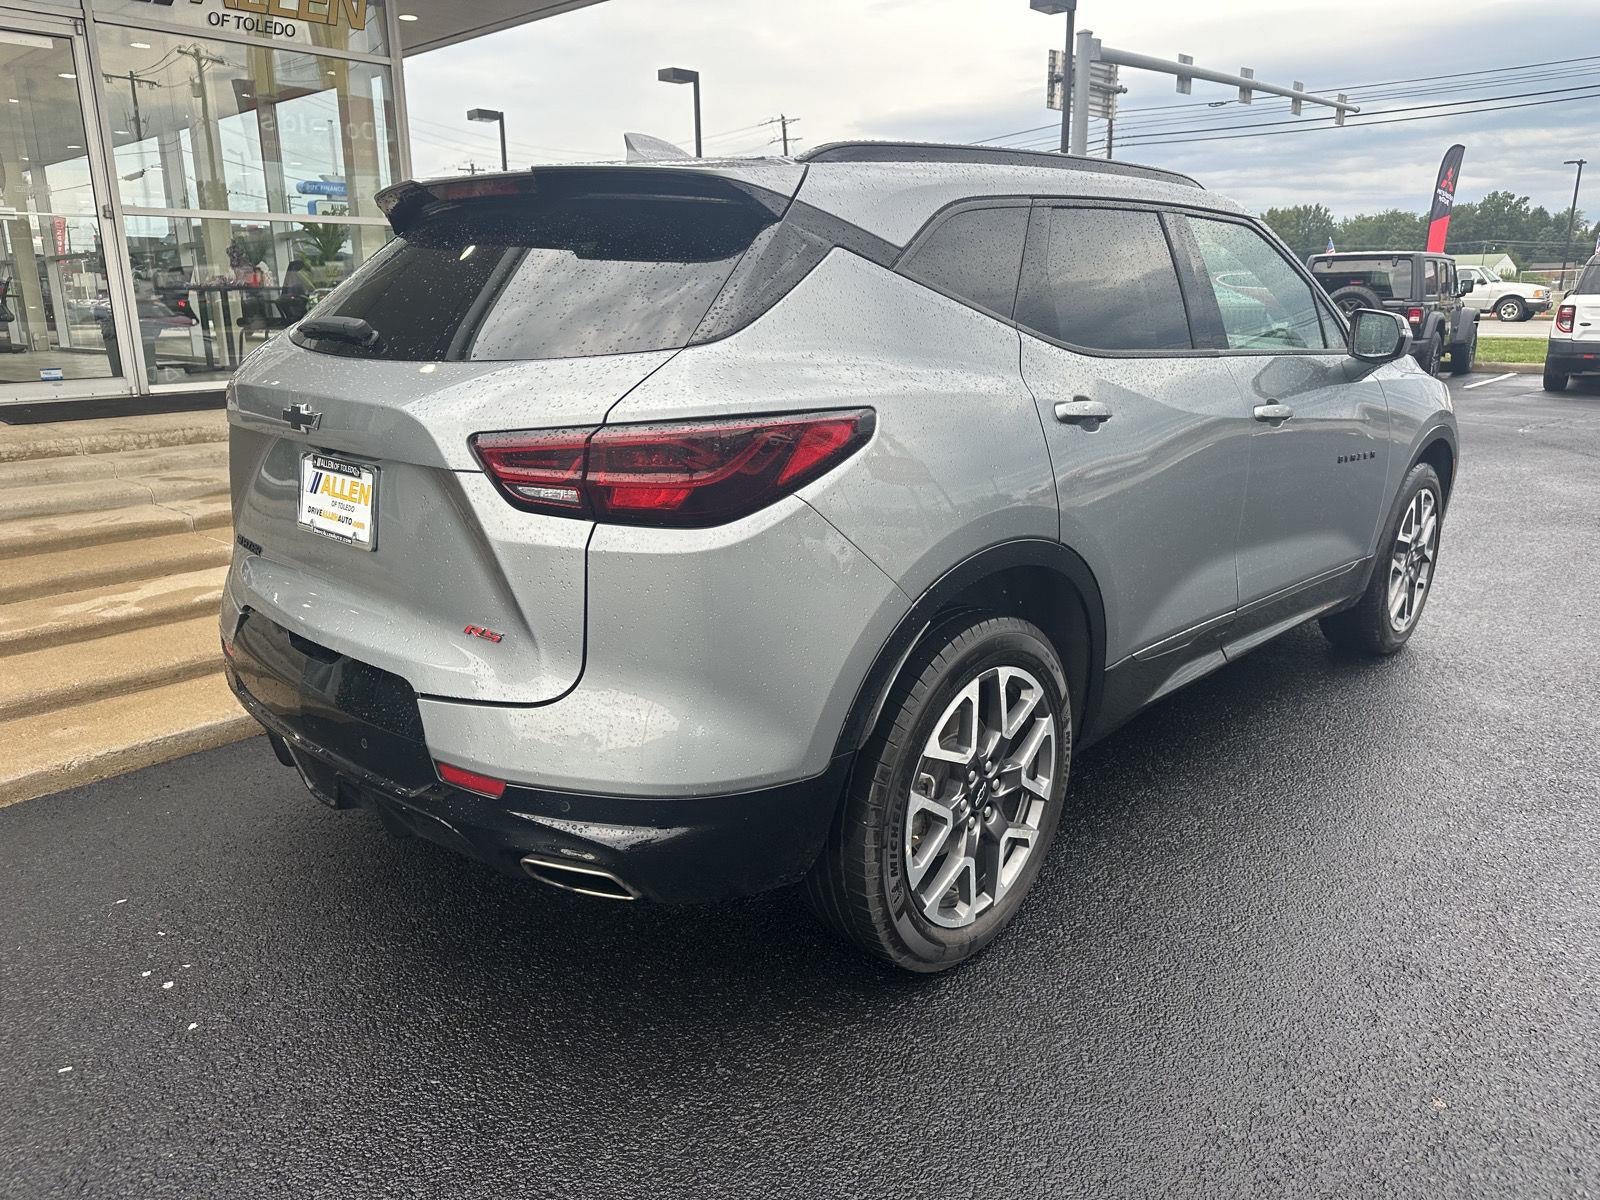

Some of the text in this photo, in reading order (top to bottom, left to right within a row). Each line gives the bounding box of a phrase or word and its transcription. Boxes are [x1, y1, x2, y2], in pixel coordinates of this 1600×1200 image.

[207, 11, 297, 38] OF TOLEDO
[320, 474, 372, 506] ALLEN
